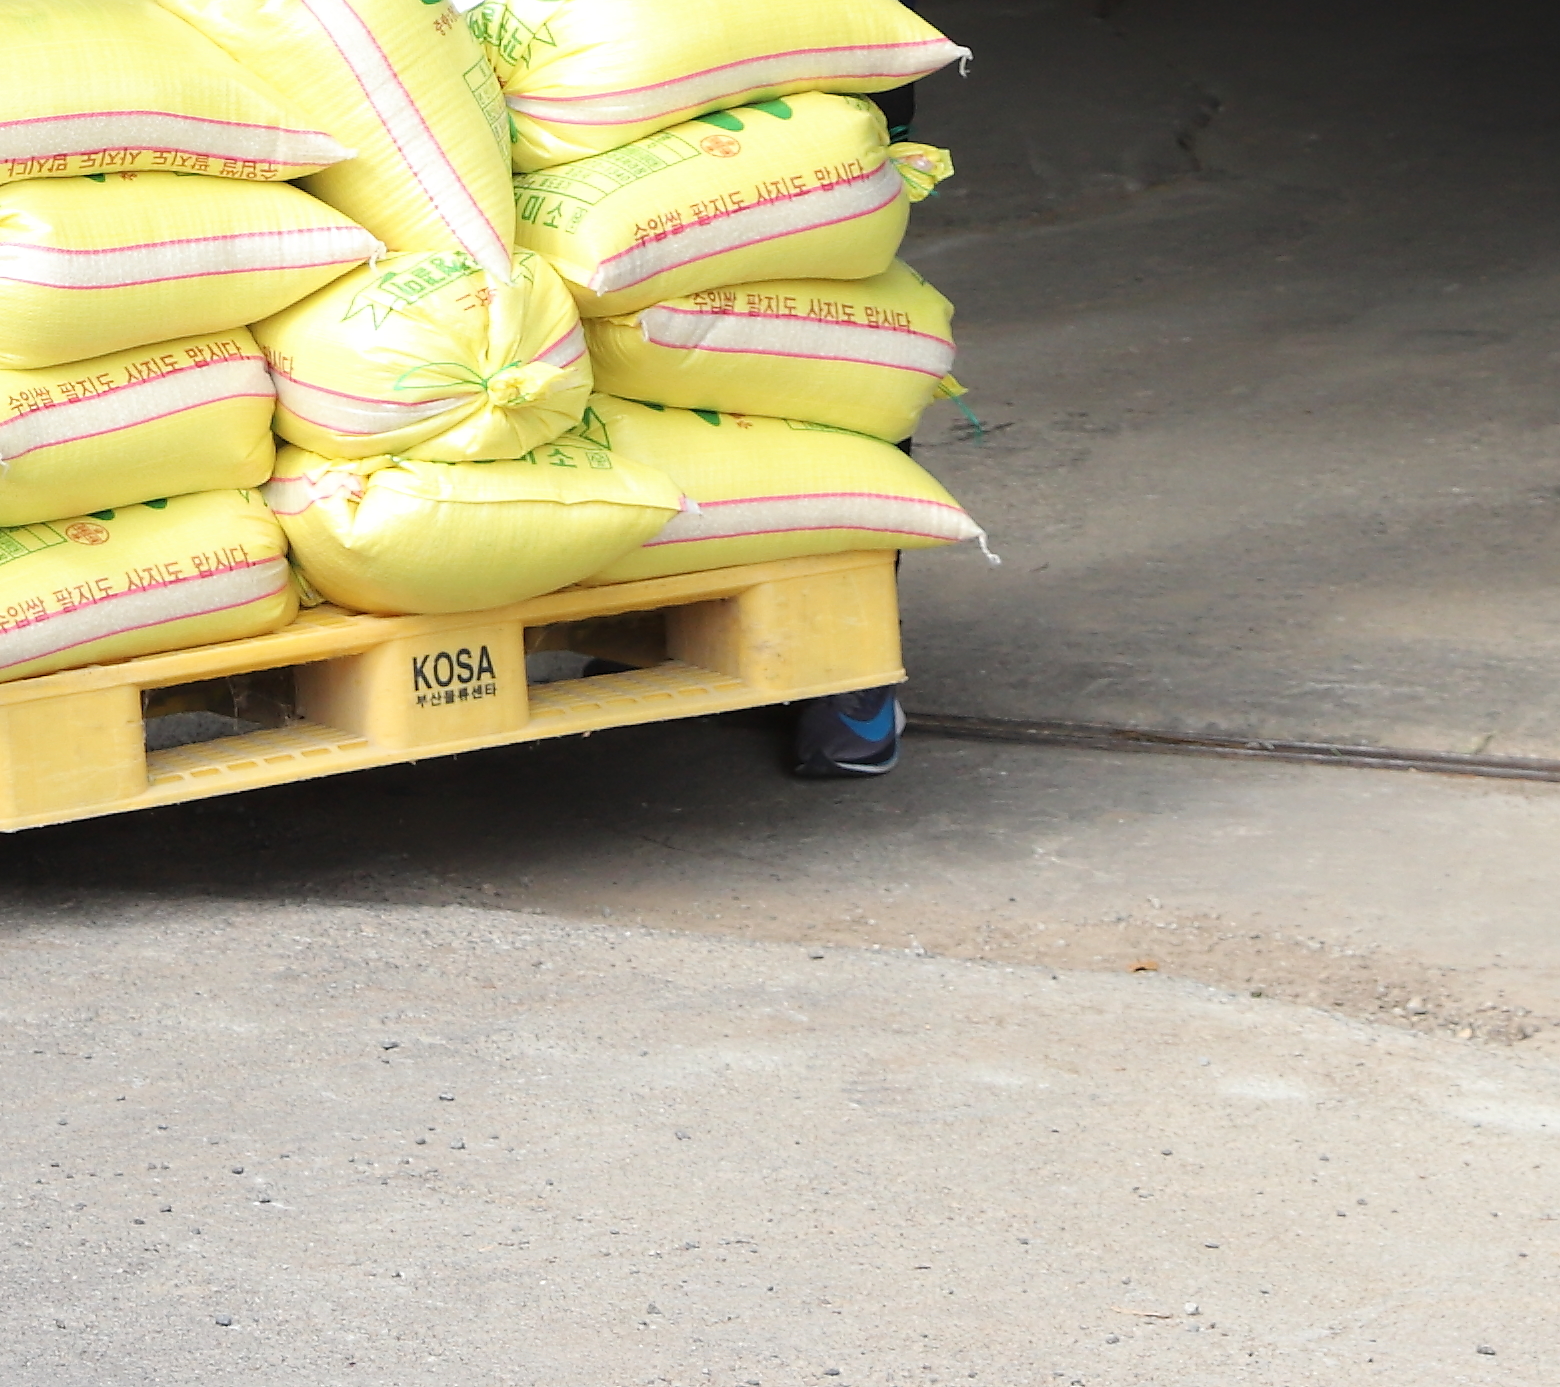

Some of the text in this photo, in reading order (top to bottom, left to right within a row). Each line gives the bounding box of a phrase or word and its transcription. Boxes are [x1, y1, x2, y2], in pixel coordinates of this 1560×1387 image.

[633, 208, 686, 247] 수입쌀
[688, 189, 751, 227] 팔지도
[755, 174, 813, 206] 사지도
[814, 158, 871, 193] 맙시다.
[691, 291, 737, 314] 수입쌀
[745, 293, 799, 319] 팔지도
[807, 298, 857, 324] 사지도
[8, 339, 251, 417] 수입쌀 팔지도 사지도 맙시다.
[52, 576, 119, 614] 팔지도
[126, 561, 187, 592] 사지도
[191, 543, 257, 579] 맙시다.
[412, 644, 497, 692] KOSA
